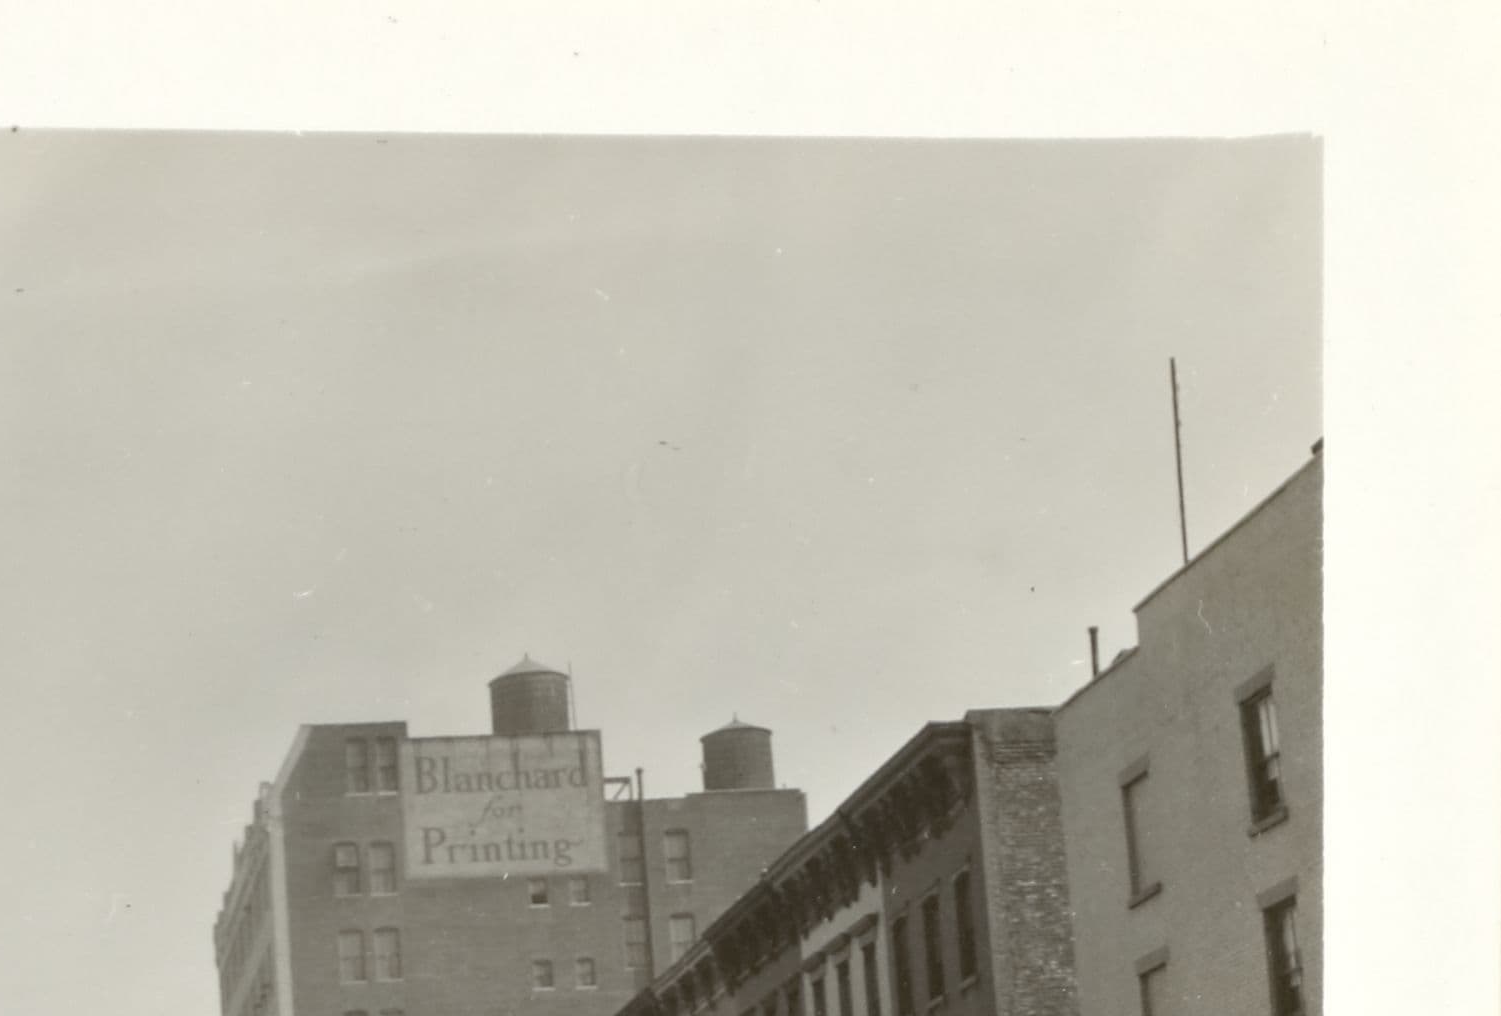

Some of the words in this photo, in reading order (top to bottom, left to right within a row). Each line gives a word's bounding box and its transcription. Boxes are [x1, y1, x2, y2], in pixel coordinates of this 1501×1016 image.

[414, 751, 588, 795] Blanchard
[469, 795, 523, 827] for
[421, 827, 583, 867] Printing
